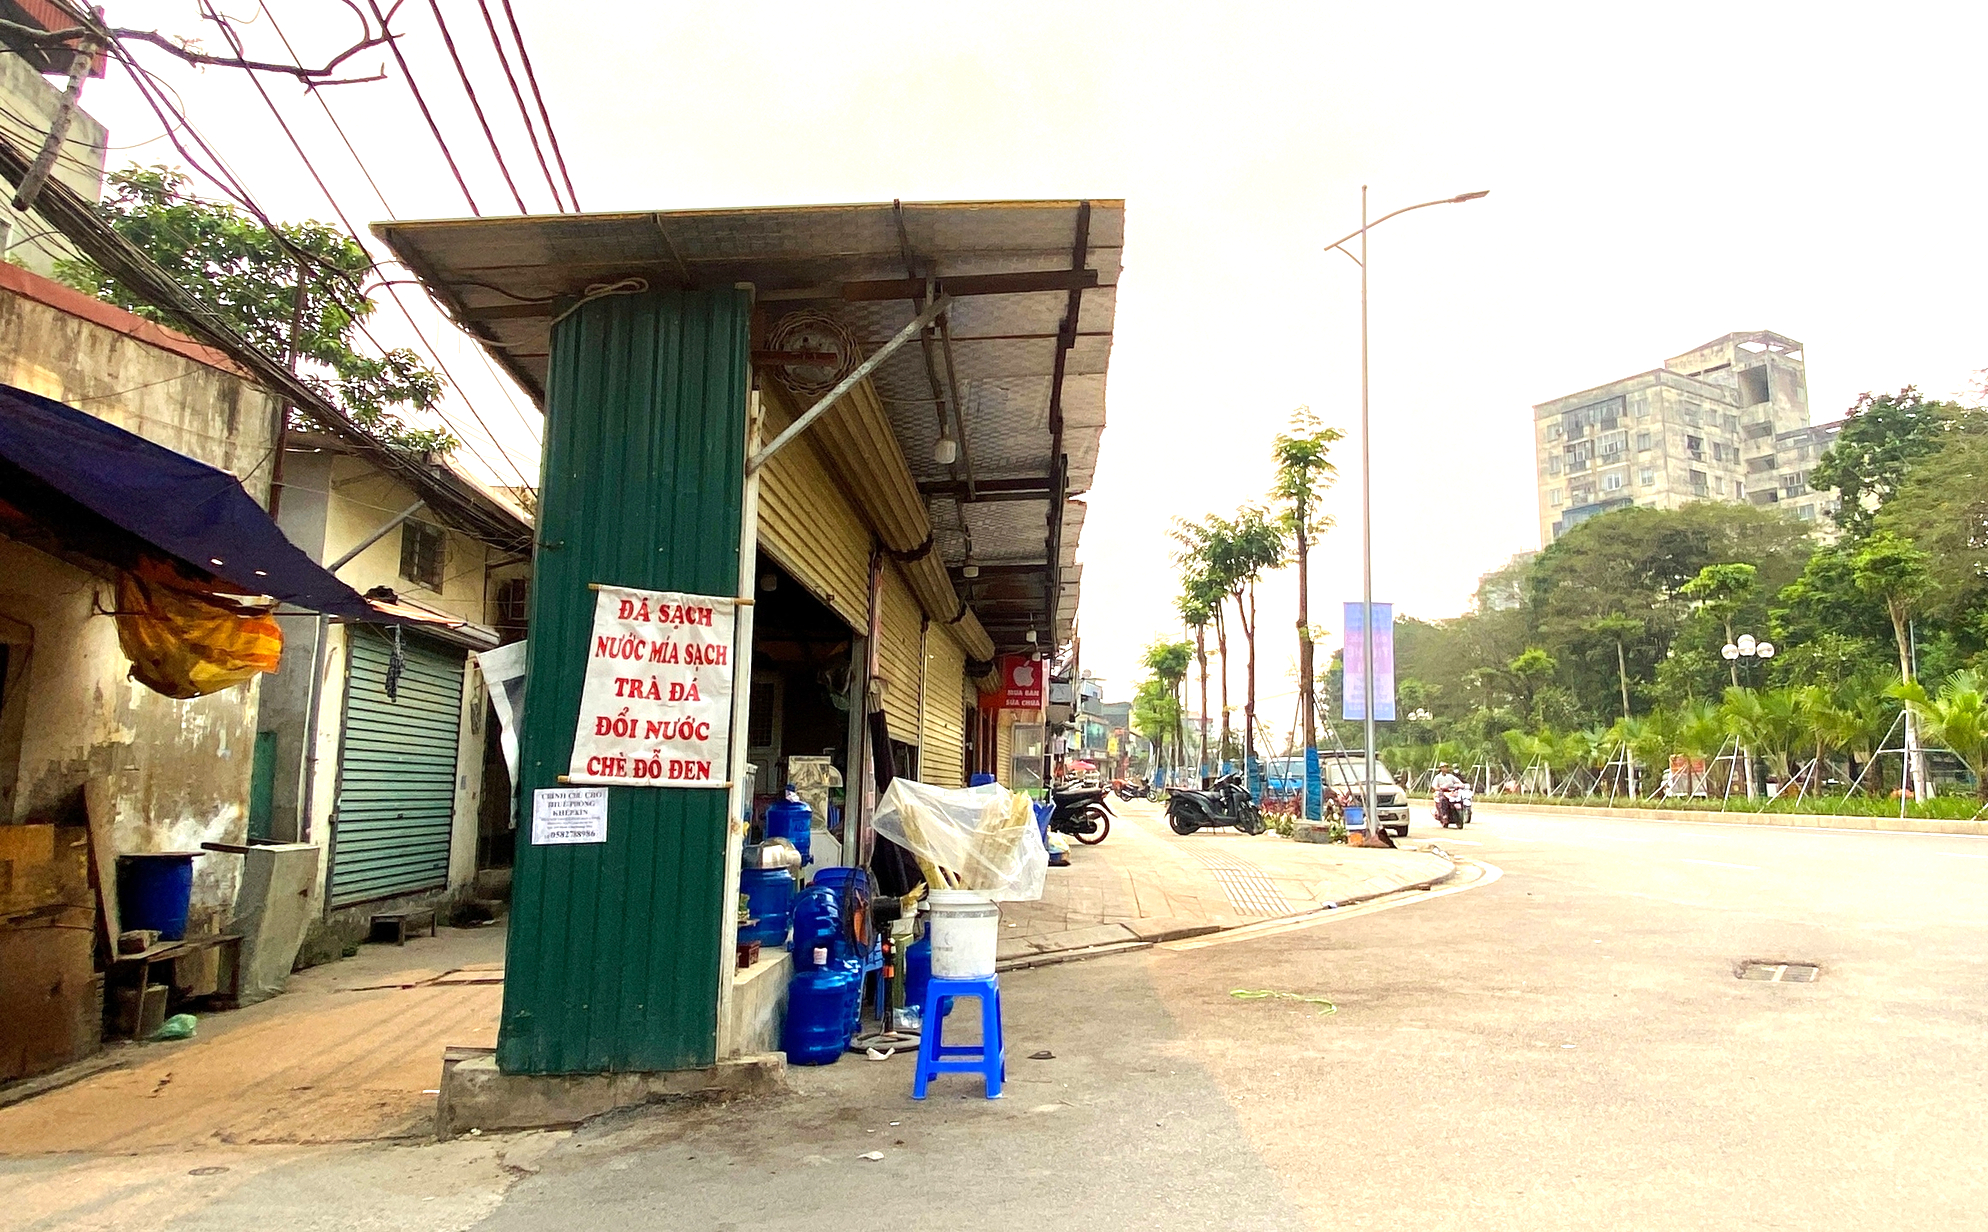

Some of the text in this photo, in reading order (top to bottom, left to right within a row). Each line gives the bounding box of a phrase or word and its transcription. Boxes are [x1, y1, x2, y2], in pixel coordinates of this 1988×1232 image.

[618, 597, 713, 629] ĐÁ SẠCH
[595, 632, 727, 671] NƯỚC MÍA SẠCH
[614, 675, 700, 701] TRÀ ĐÁ
[595, 707, 709, 741] ĐỔI NƯỚC
[587, 749, 711, 780] CHÈ ĐỖ ĐEN
